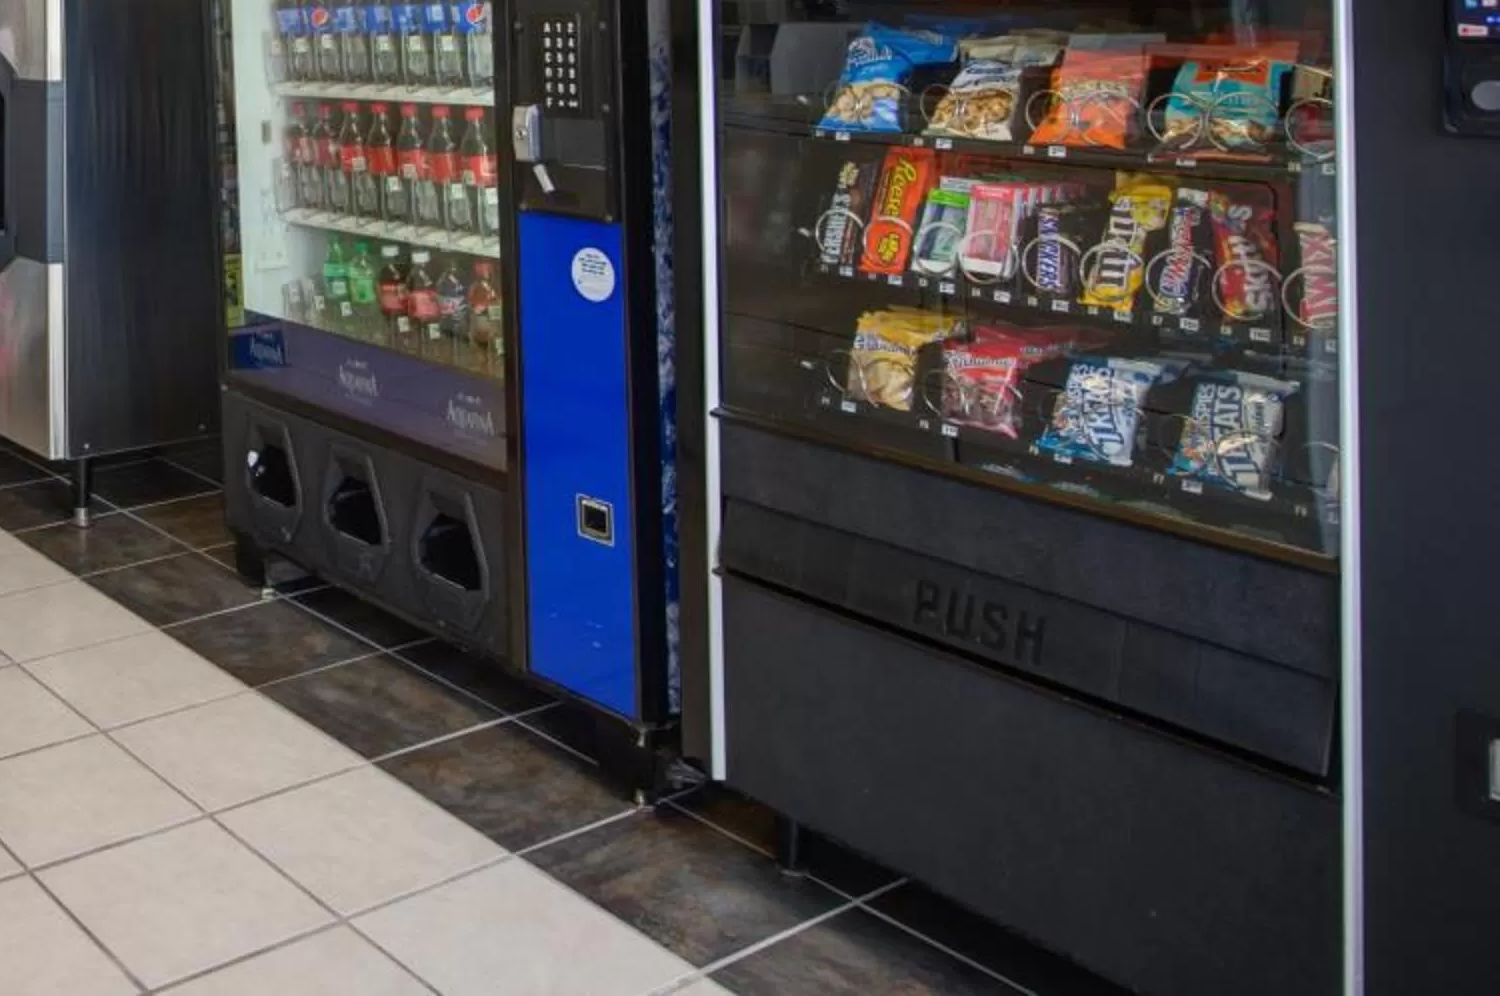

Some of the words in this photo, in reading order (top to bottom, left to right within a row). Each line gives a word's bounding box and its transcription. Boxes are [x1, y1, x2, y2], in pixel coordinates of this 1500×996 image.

[1037, 215, 1061, 290] SNCKERS
[1299, 231, 1339, 321] TWIX
[912, 578, 1047, 667] PUSH
